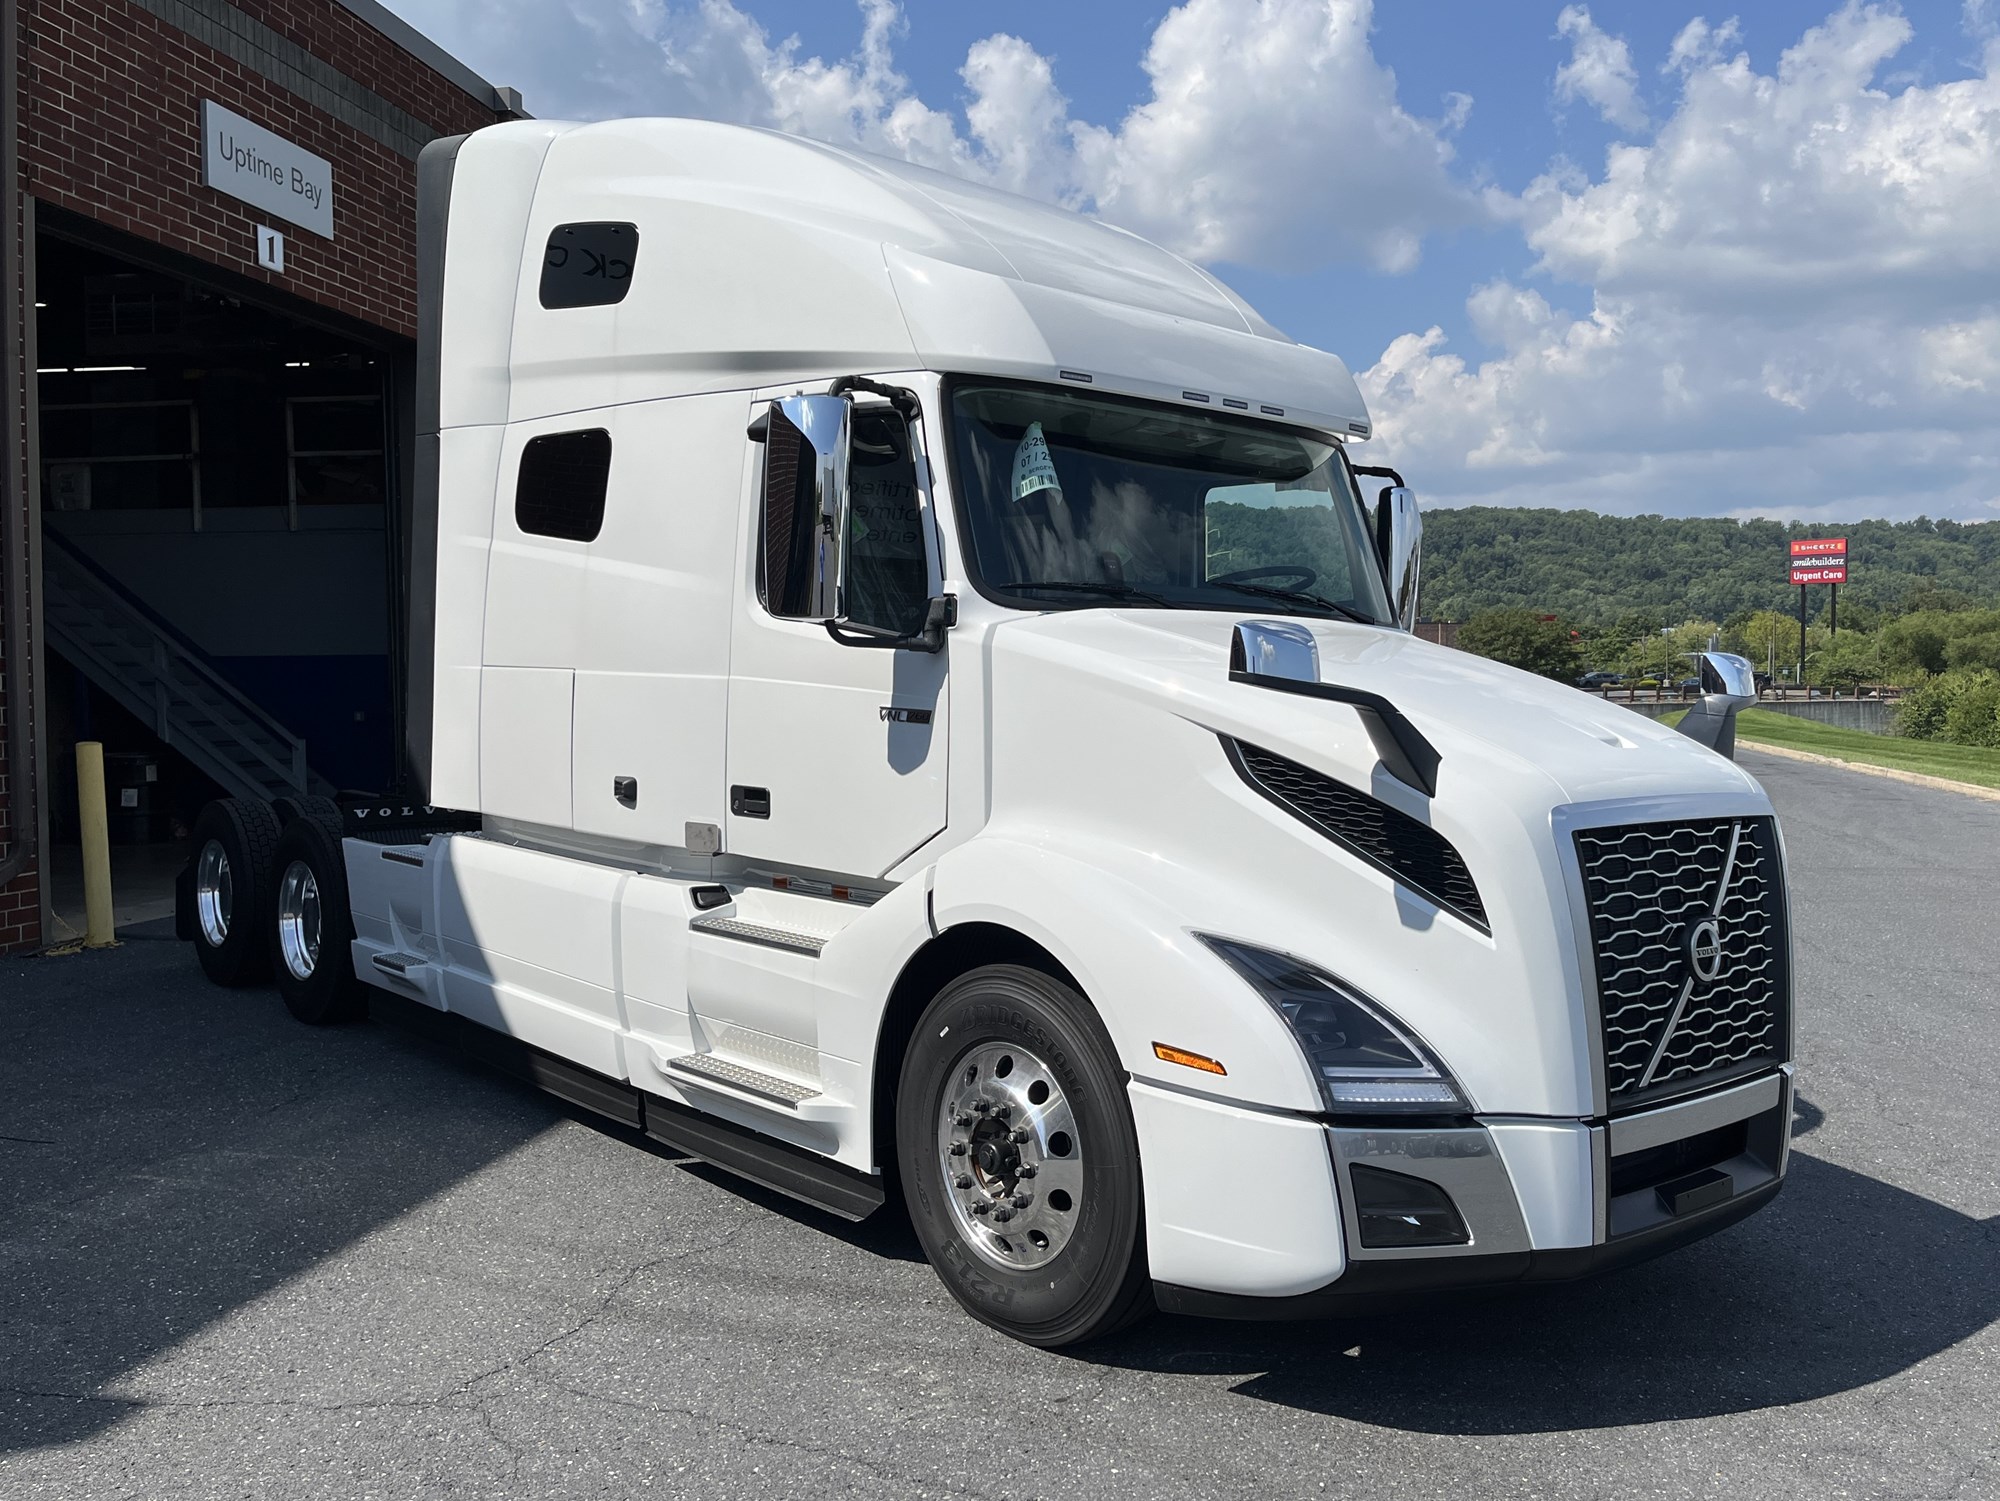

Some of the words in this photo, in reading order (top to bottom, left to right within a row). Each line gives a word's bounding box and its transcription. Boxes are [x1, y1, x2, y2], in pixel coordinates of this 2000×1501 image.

[220, 131, 284, 186] Uptime
[291, 167, 322, 210] Bay
[266, 235, 275, 263] 1
[1021, 455, 1031, 468] 07
[1800, 543, 1836, 551] SHEETZ
[1792, 557, 1845, 567] smilebuilderz
[1793, 571, 1822, 581] Urgent
[1823, 570, 1843, 579] Care
[1696, 947, 1719, 956] VOLVO
[960, 1004, 1088, 1103] BRIDGESTONE
[940, 1239, 1017, 1304] R213
